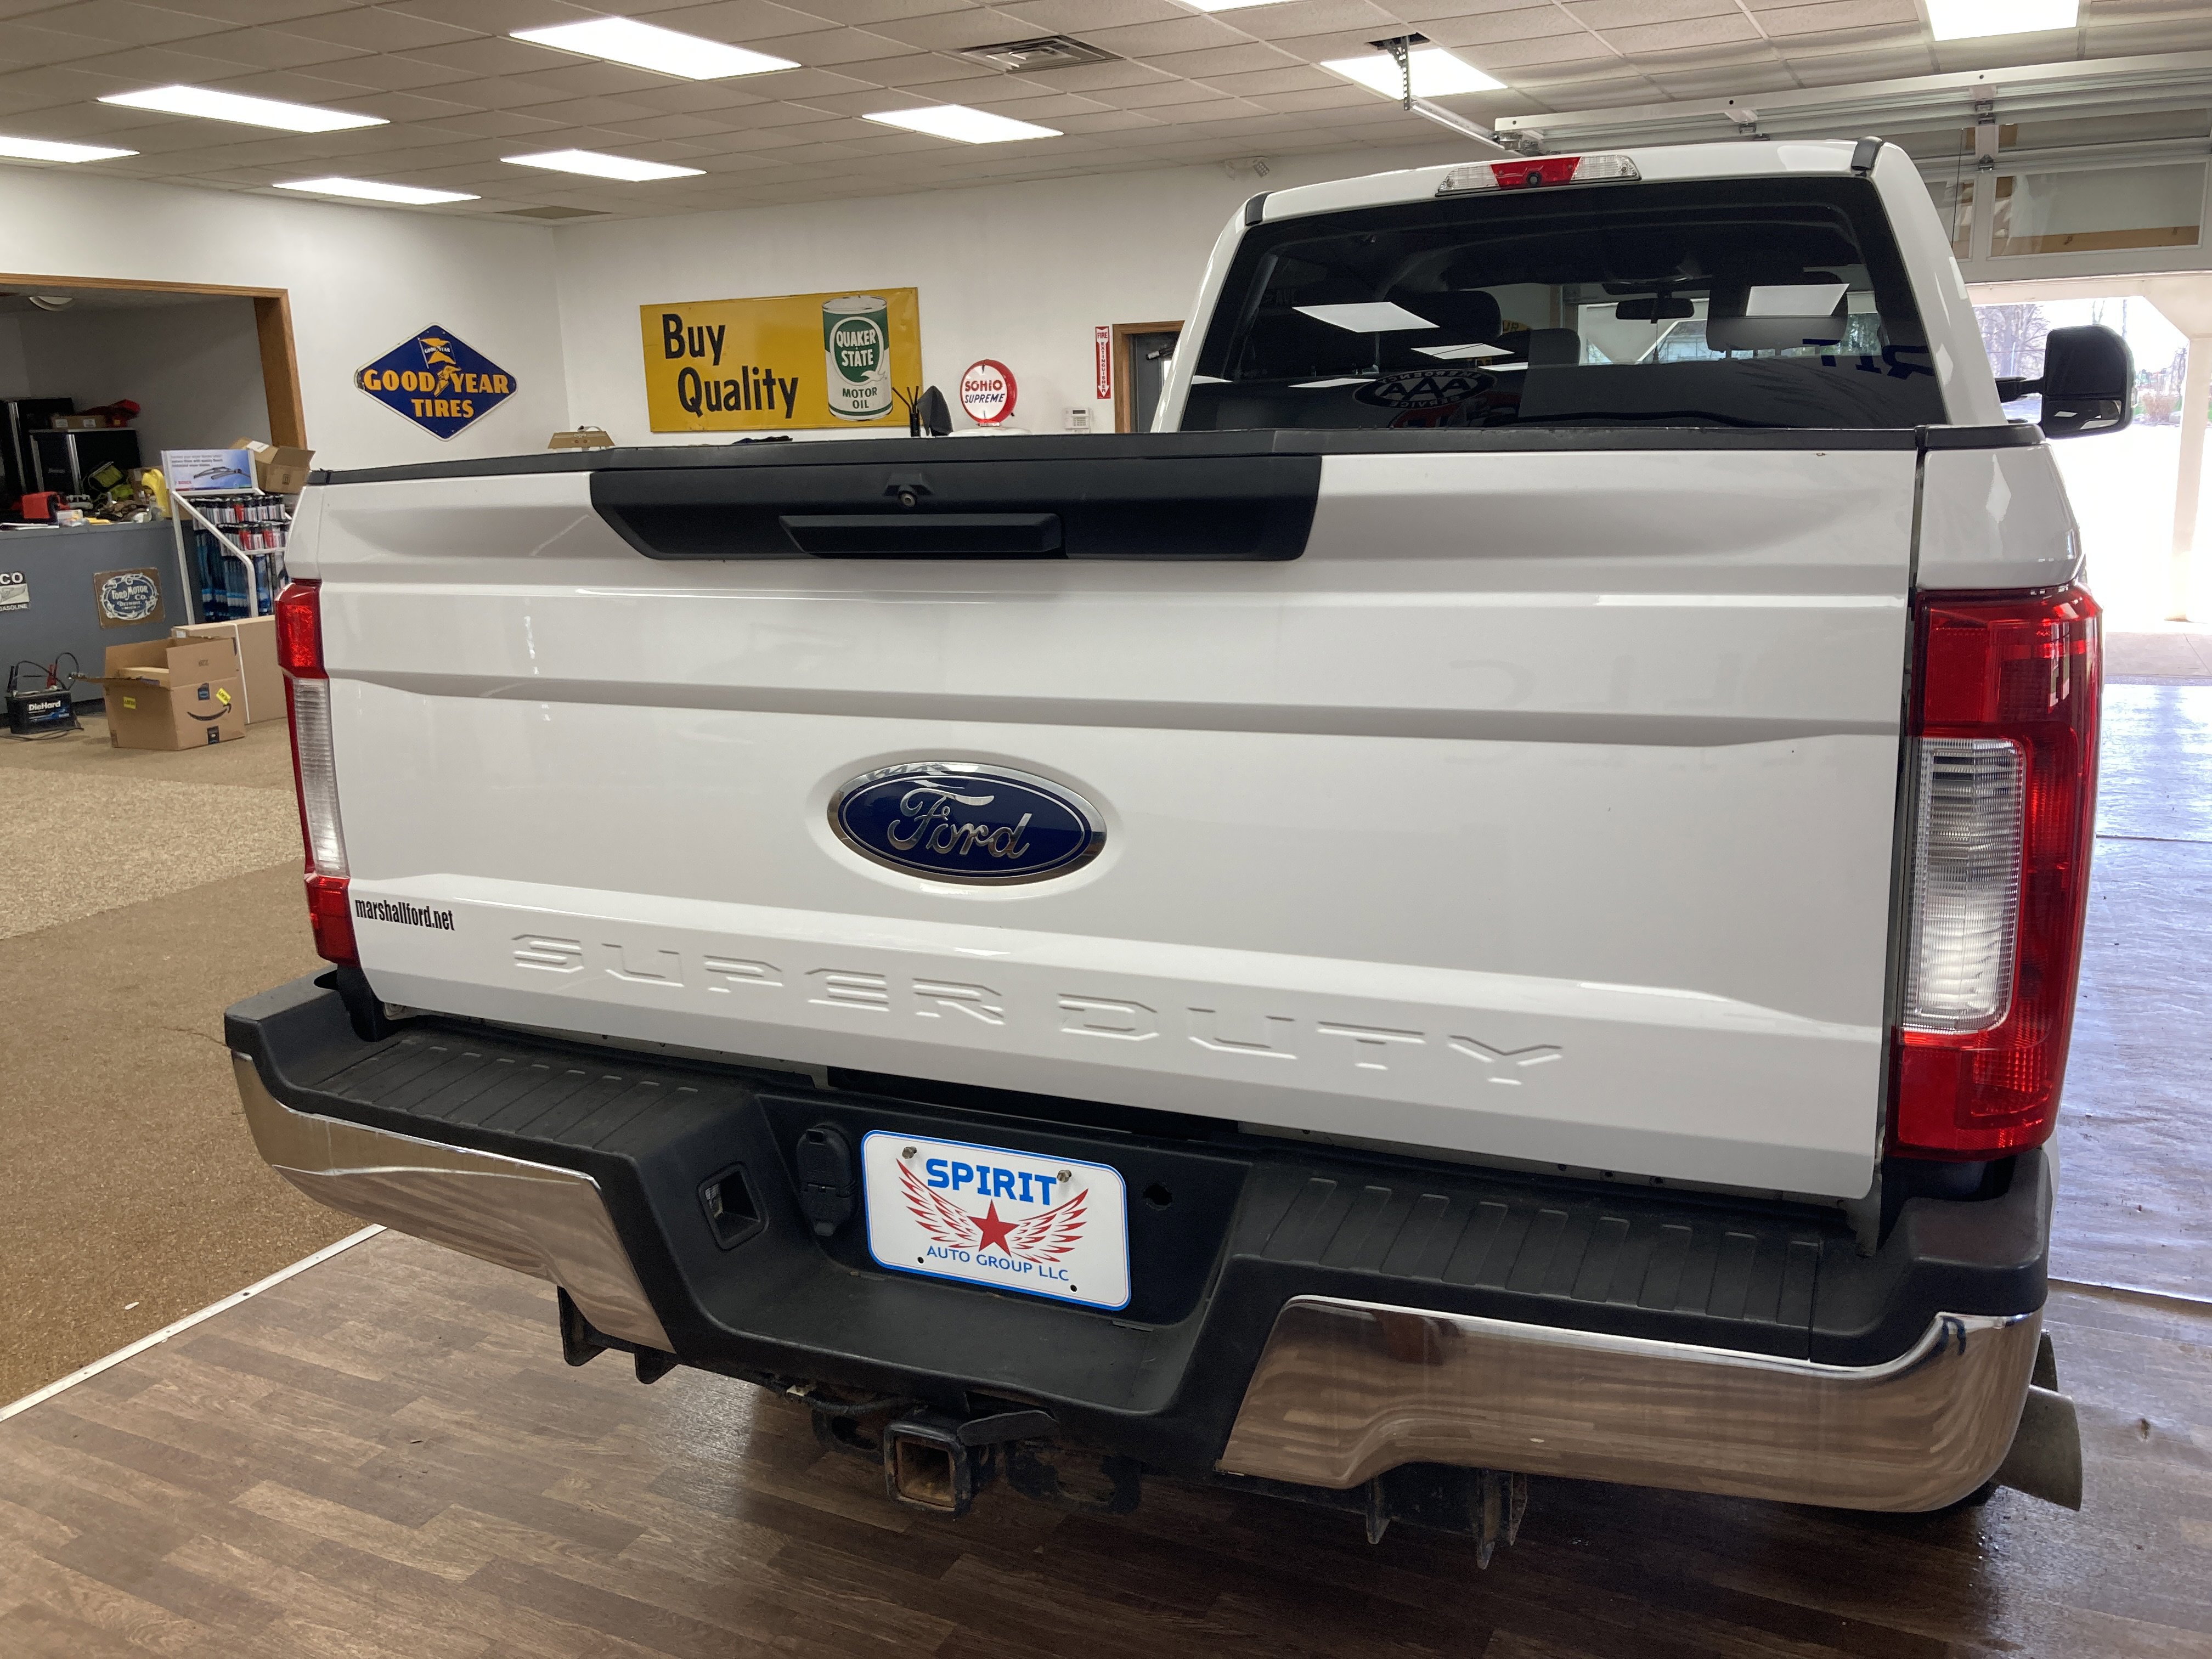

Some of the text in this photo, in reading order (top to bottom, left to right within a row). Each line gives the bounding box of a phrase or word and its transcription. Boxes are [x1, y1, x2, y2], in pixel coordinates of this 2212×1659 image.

[662, 313, 726, 366] Buy
[836, 329, 877, 348] QUAKER
[841, 349, 874, 368] STATE
[678, 365, 799, 419] Quality
[842, 387, 878, 399] MOTOR
[965, 380, 1003, 392] SOHIO
[852, 400, 870, 410] OIL
[964, 393, 1005, 404] SUPREME
[411, 399, 475, 419] TIRES
[112, 585, 149, 600] FORD MOTOR
[29, 700, 61, 711] DieHard
[887, 788, 1032, 859] Ford
[355, 899, 455, 930] marshallford.net
[511, 933, 1564, 1085] SUPER DUTY
[926, 1158, 1057, 1206] SPIRIT
[927, 1245, 1070, 1282] AUTO GROUP LLC
